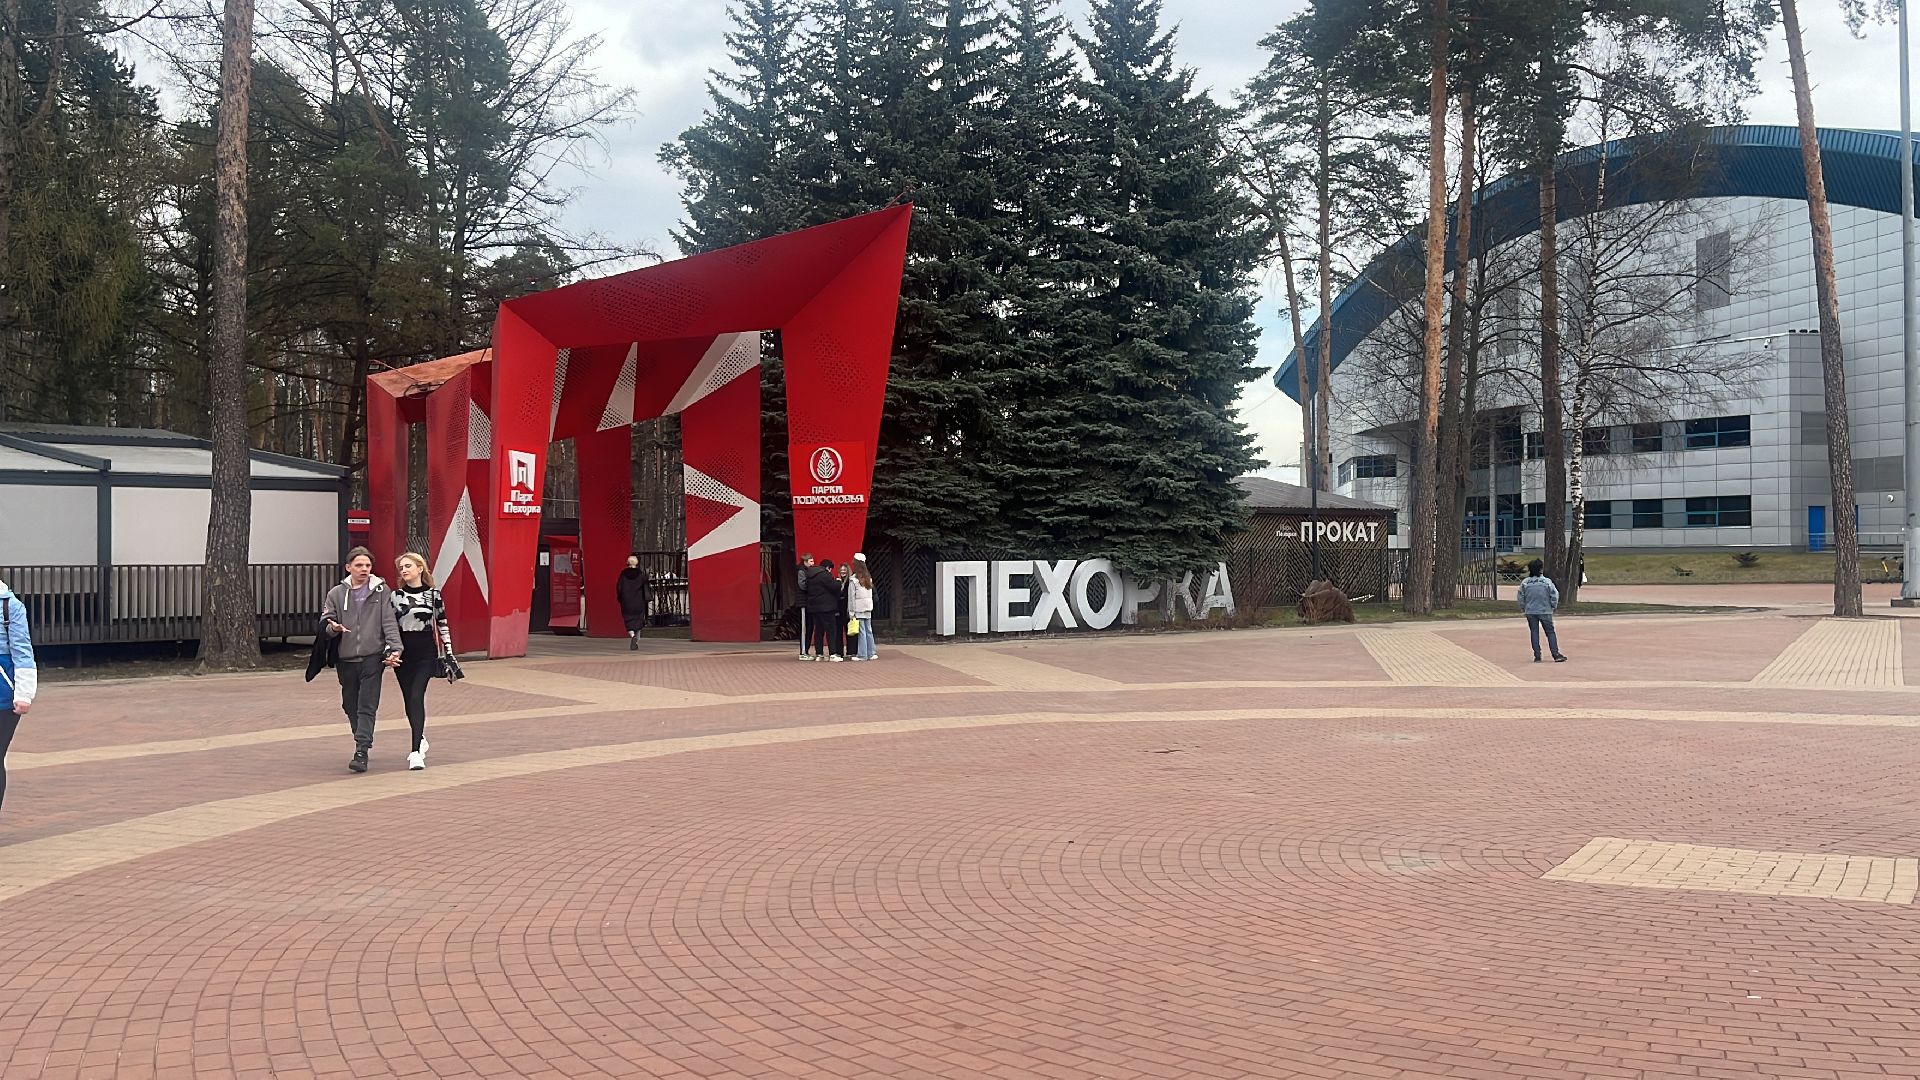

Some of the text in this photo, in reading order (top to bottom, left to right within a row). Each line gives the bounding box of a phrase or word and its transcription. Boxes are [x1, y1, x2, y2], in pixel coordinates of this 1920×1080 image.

[510, 489, 534, 505] Парк
[811, 486, 844, 494] ПАРКИ
[793, 494, 865, 505] ПОДМОСКОВЬЯ
[503, 502, 541, 517] Пехорка
[1301, 521, 1379, 542] ПРОКАТ
